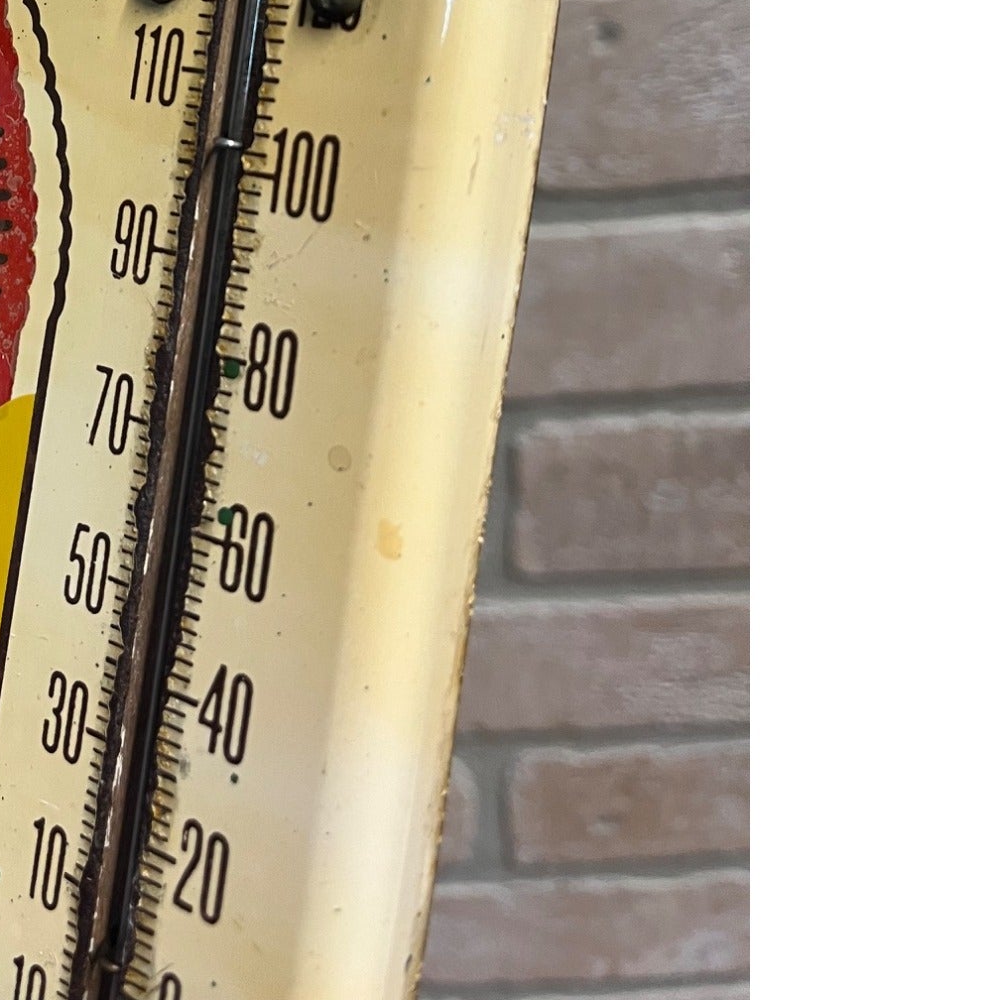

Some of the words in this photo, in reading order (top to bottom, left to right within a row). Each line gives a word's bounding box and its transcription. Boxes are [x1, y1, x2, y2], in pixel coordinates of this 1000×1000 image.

[130, 23, 184, 106] 110
[270, 127, 341, 222] 100
[110, 199, 158, 285] 90
[88, 364, 134, 455] 70
[243, 323, 298, 419] 80
[64, 523, 111, 614] 50
[219, 503, 275, 603] 60
[41, 670, 89, 764] 30
[198, 663, 254, 765] 40
[29, 817, 68, 910] 10
[173, 818, 230, 925] 20
